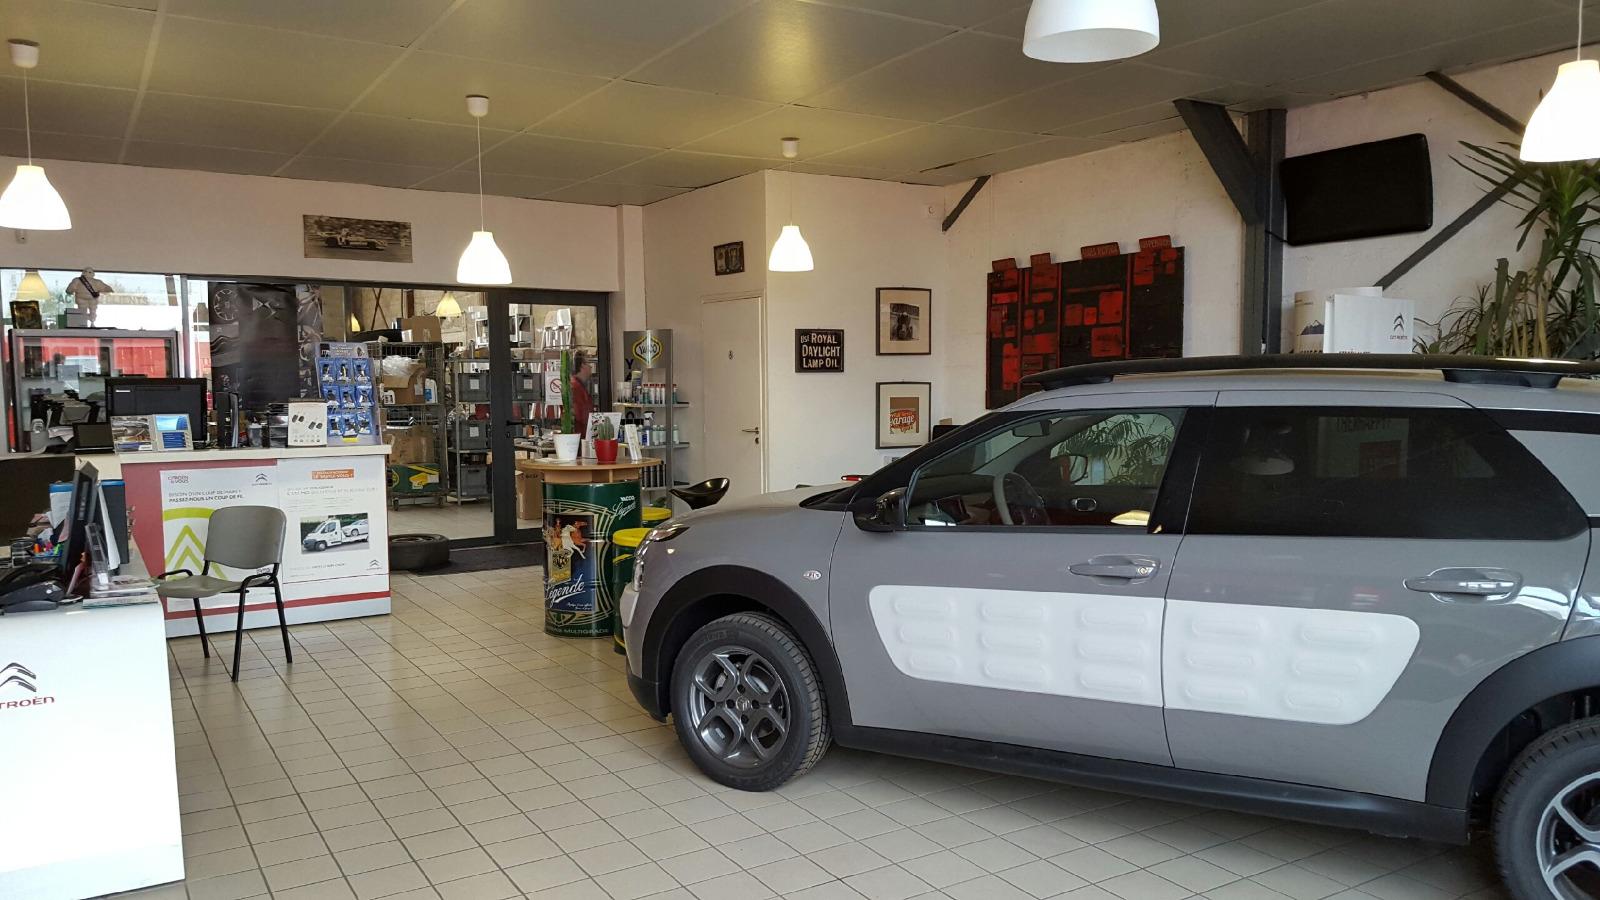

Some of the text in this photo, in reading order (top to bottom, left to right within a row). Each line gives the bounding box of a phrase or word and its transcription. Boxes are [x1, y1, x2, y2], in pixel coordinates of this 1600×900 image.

[811, 332, 838, 344] ROYAL
[801, 344, 841, 357] DAYLIGHT
[803, 357, 839, 369] LAMP OIL
